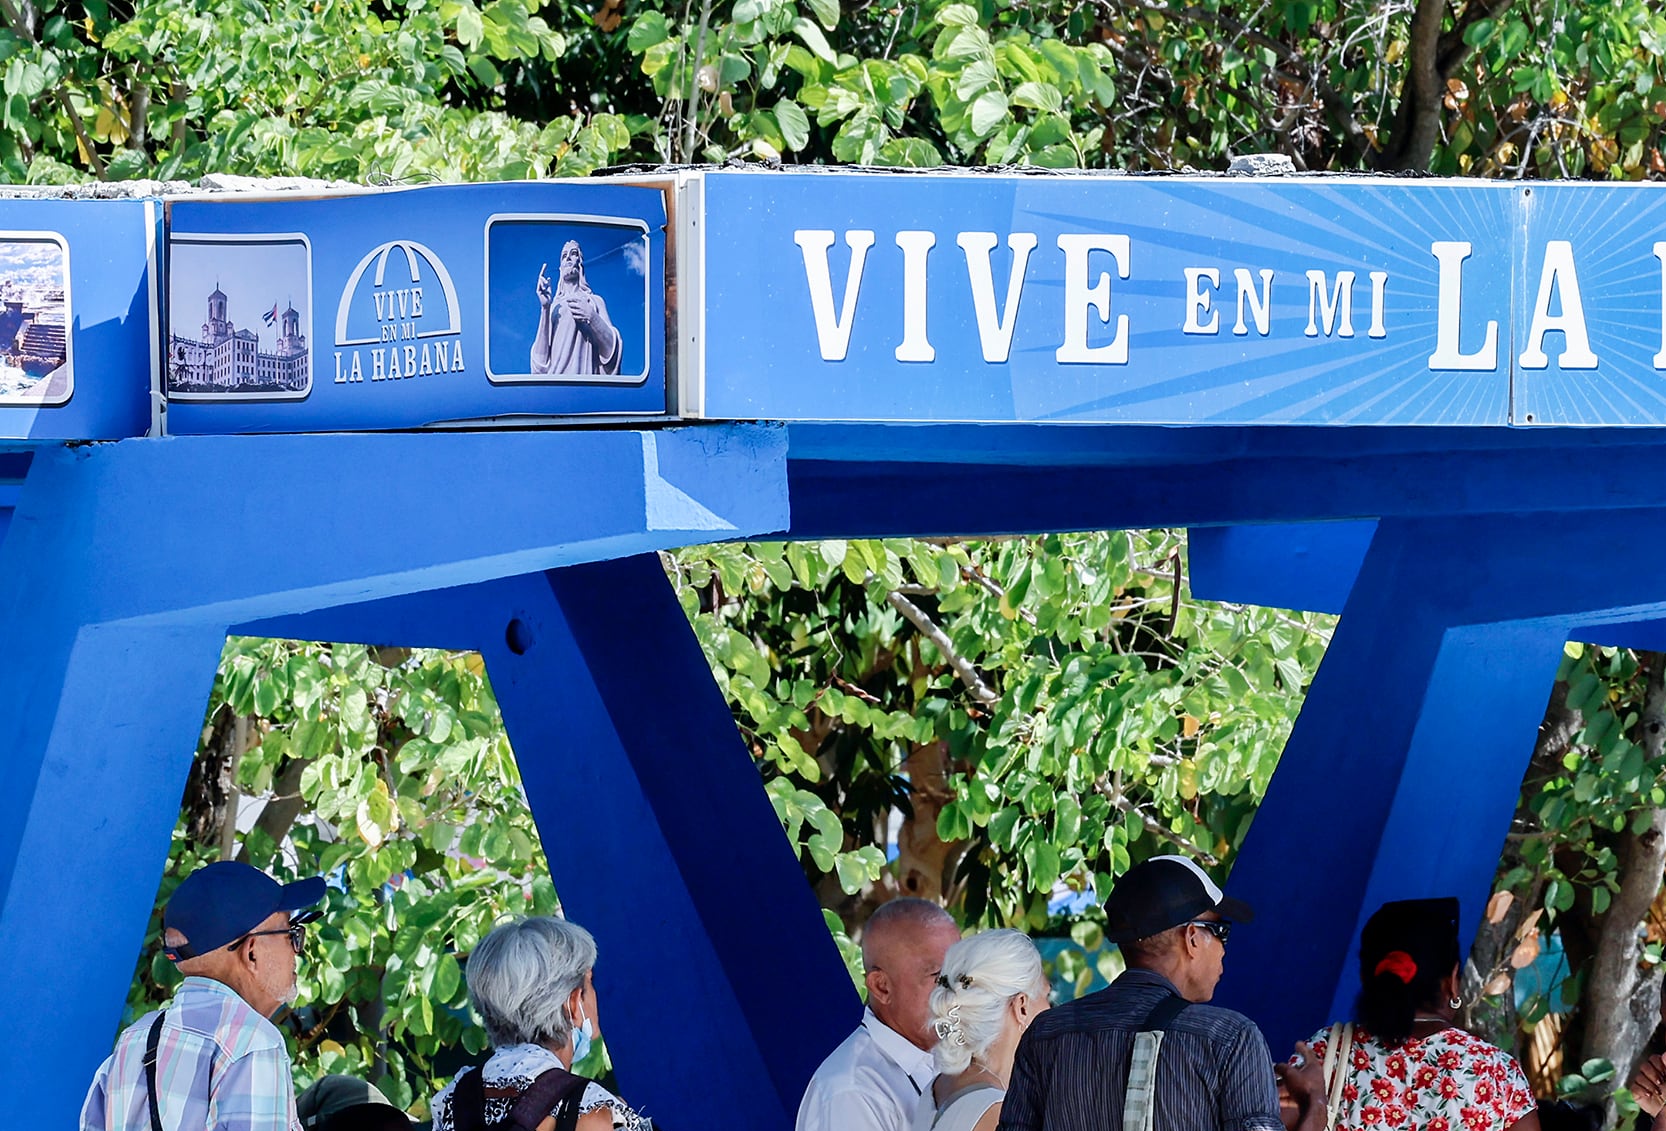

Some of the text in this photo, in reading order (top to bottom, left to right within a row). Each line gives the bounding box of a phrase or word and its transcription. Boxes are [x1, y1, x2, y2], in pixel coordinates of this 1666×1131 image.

[374, 287, 422, 321] VIVE
[794, 229, 1130, 364] VIVE
[1182, 267, 1275, 336] EN
[1304, 269, 1389, 338] MI
[1428, 240, 1599, 371] LA
[382, 322, 416, 342] EN MI
[334, 340, 465, 383] LA HABANA
